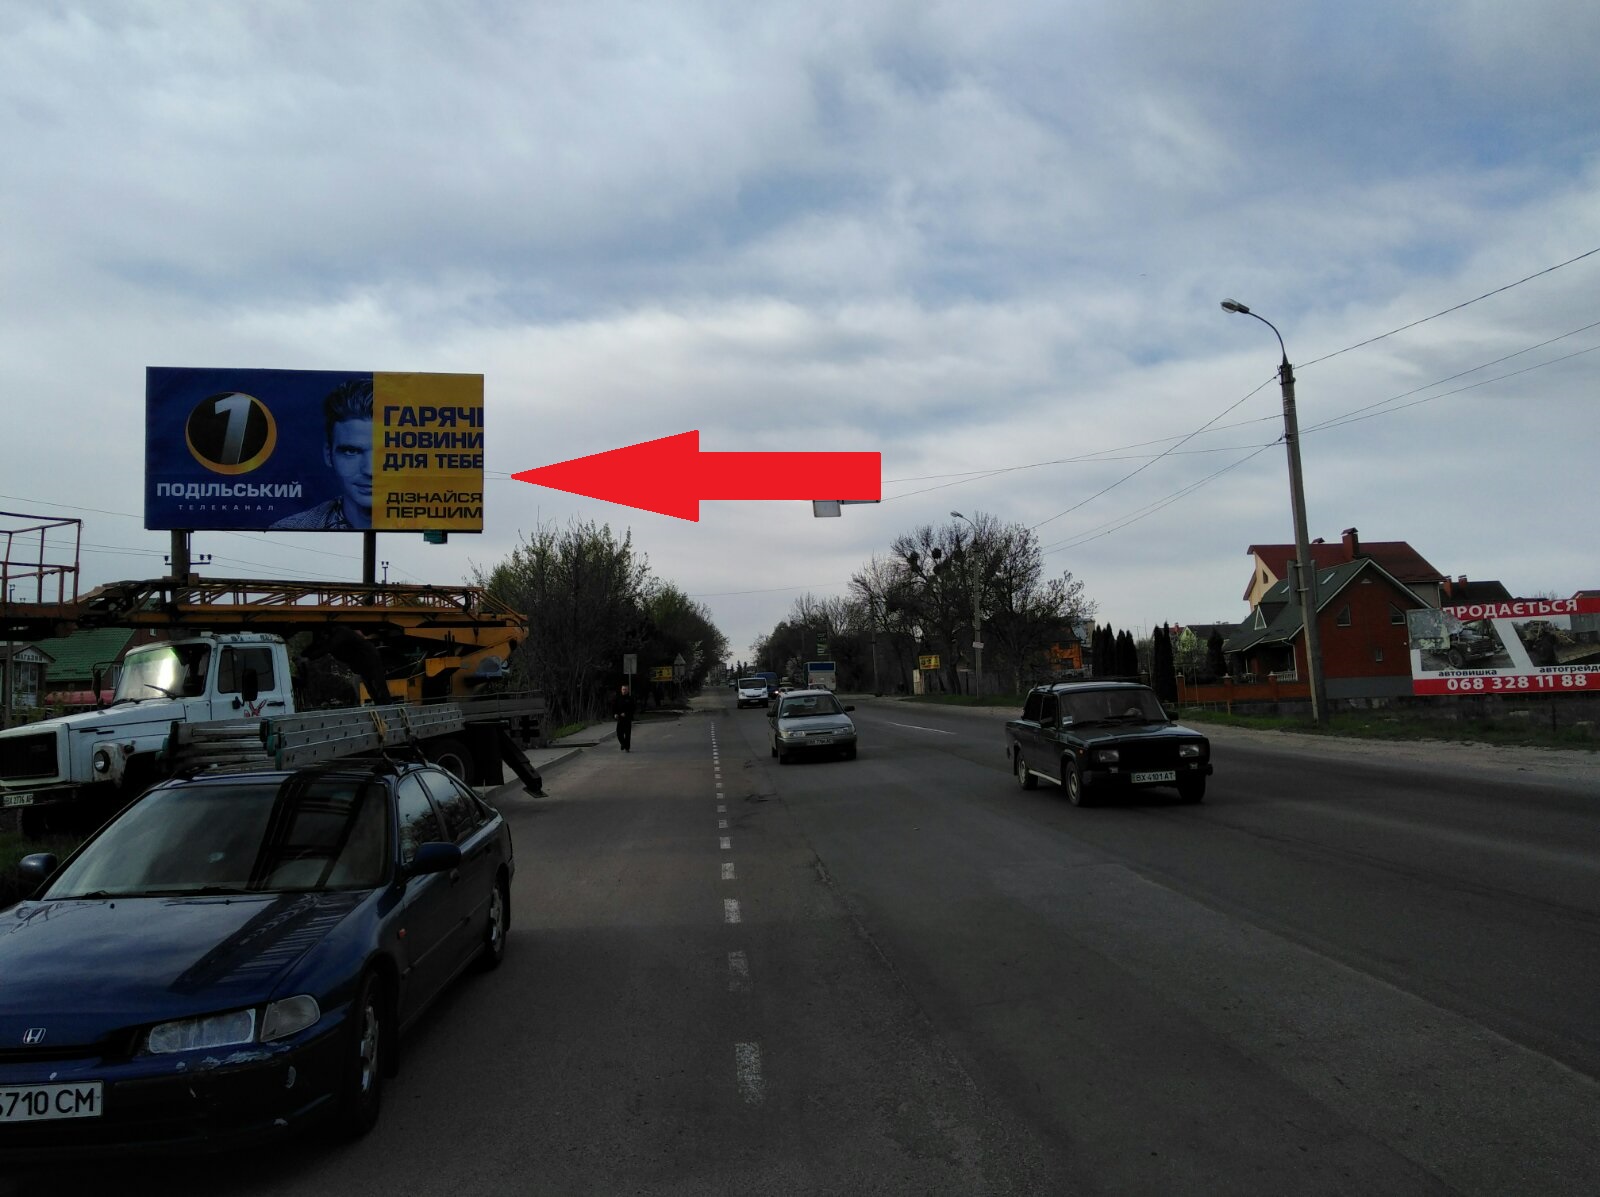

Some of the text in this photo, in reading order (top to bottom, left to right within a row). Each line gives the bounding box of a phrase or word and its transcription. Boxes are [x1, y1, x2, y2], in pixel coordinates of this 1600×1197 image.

[383, 405, 484, 428] ГАРЯЧІ
[214, 393, 252, 465] 1
[384, 431, 484, 449] НОВИНИ
[382, 452, 484, 471] ДЛЯ ТЕБЕ
[156, 481, 303, 500] ПОДІЛЬСЬКИЙ
[386, 489, 483, 505] ДІЗНАЙСЯ
[177, 503, 275, 512] ТЕЛЕКАНАЛ
[386, 506, 483, 518] ПЕРШИМ
[1438, 669, 1497, 677] автовишка
[1447, 674, 1588, 691] 068 328 11 88
[55, 1087, 95, 1114] CM
